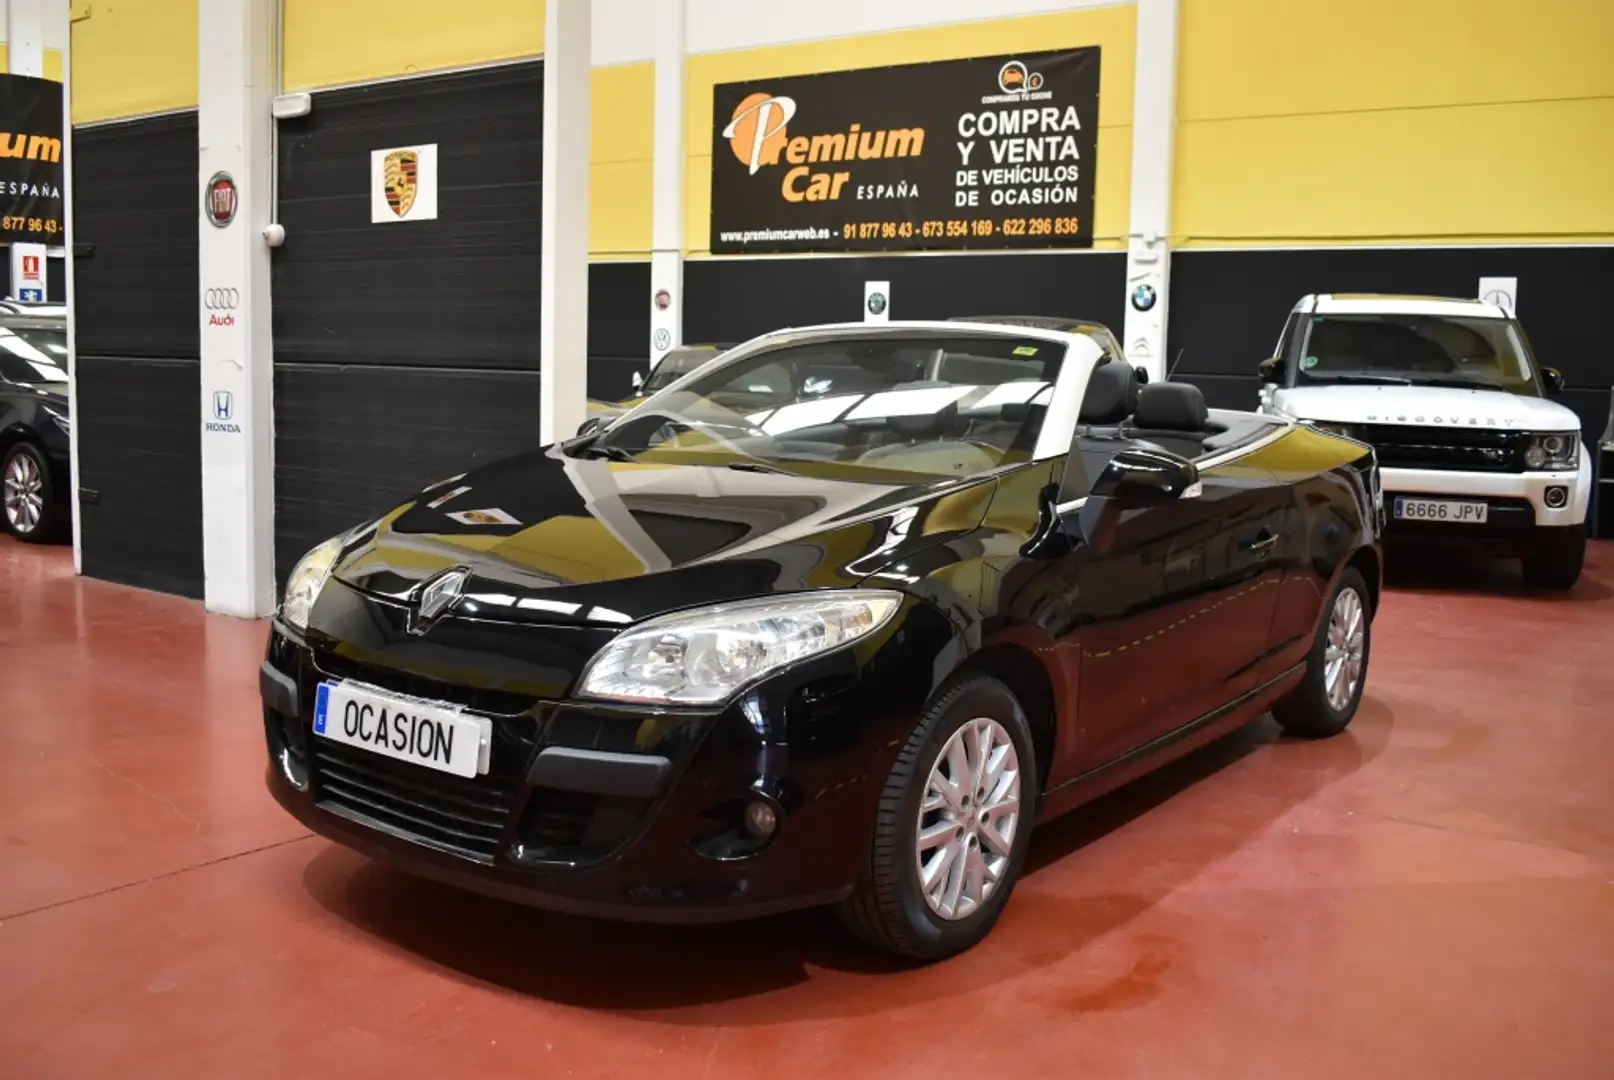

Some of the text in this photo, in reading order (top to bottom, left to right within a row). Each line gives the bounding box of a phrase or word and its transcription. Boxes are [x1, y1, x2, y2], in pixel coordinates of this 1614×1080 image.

[957, 105, 1081, 138] COMPRA
[722, 95, 925, 176] Premium
[956, 135, 1080, 166] Y VENTA
[781, 165, 919, 203] Car ESPAÑA
[955, 164, 1079, 187] DE VEHÍCULOS
[955, 183, 1078, 207] DE OCASIÓN
[3, 216, 25, 231] 877
[28, 217, 42, 232] 96
[44, 219, 57, 233] 43
[720, 226, 830, 244] www.premiumcarweb.es
[843, 223, 856, 239] 91
[859, 222, 880, 239] 877
[882, 222, 896, 238] 96
[898, 221, 912, 238] 43
[922, 220, 944, 237] 673
[946, 220, 968, 236] 554
[971, 219, 993, 236] 169
[1003, 218, 1025, 236] 622
[1028, 218, 1051, 235] 296
[1054, 217, 1078, 235] 836
[209, 314, 235, 326] Audi
[205, 422, 241, 434] HONDA
[1405, 502, 1486, 520] 6666 JPV
[343, 699, 454, 765] OCASION
